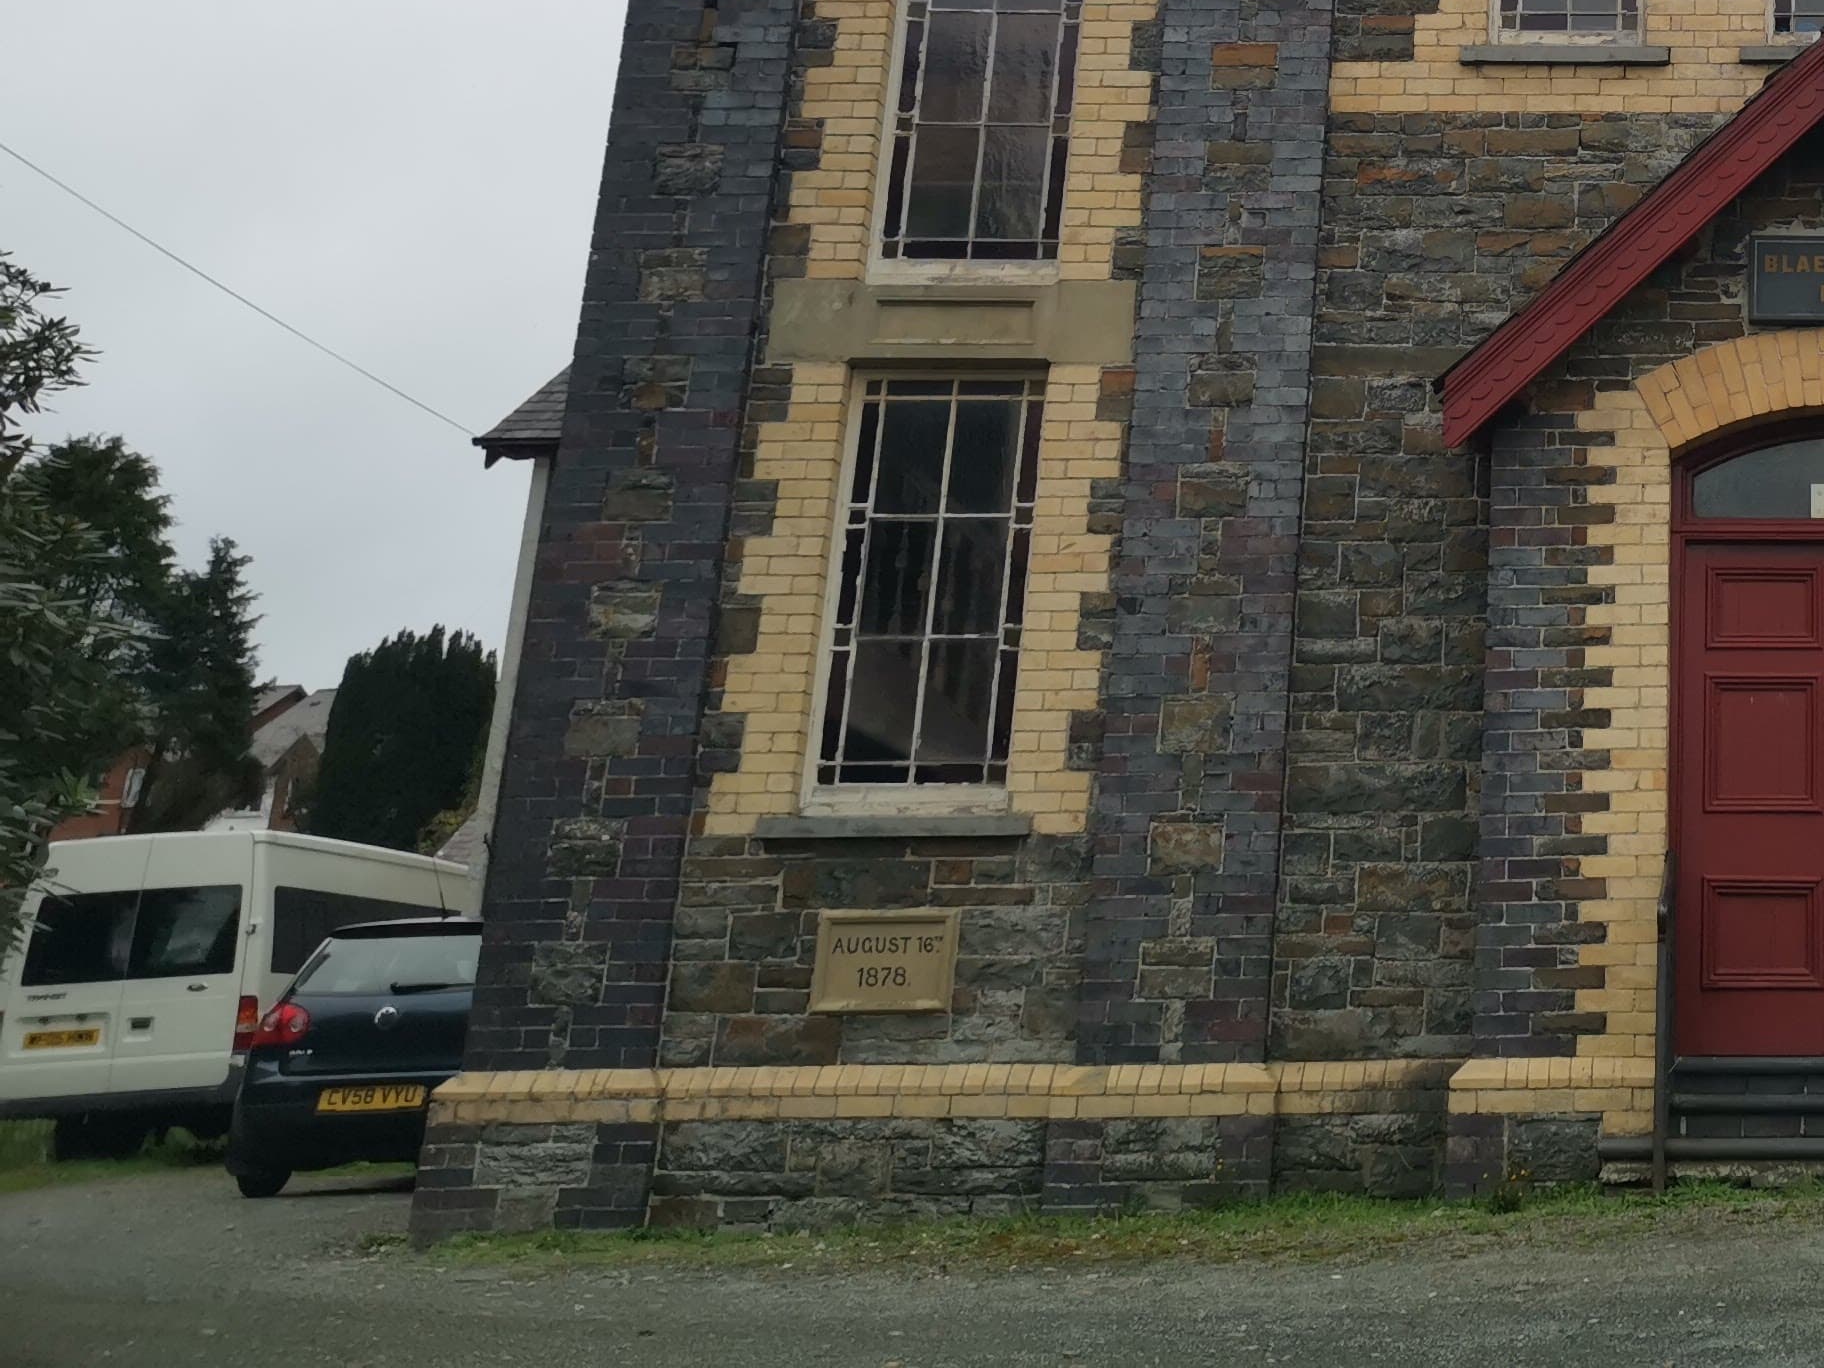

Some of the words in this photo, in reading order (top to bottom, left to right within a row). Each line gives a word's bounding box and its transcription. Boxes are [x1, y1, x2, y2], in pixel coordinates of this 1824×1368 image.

[831, 935, 912, 954] AUGUST
[326, 1088, 376, 1106] CV58
[381, 1085, 418, 1104] VYU
